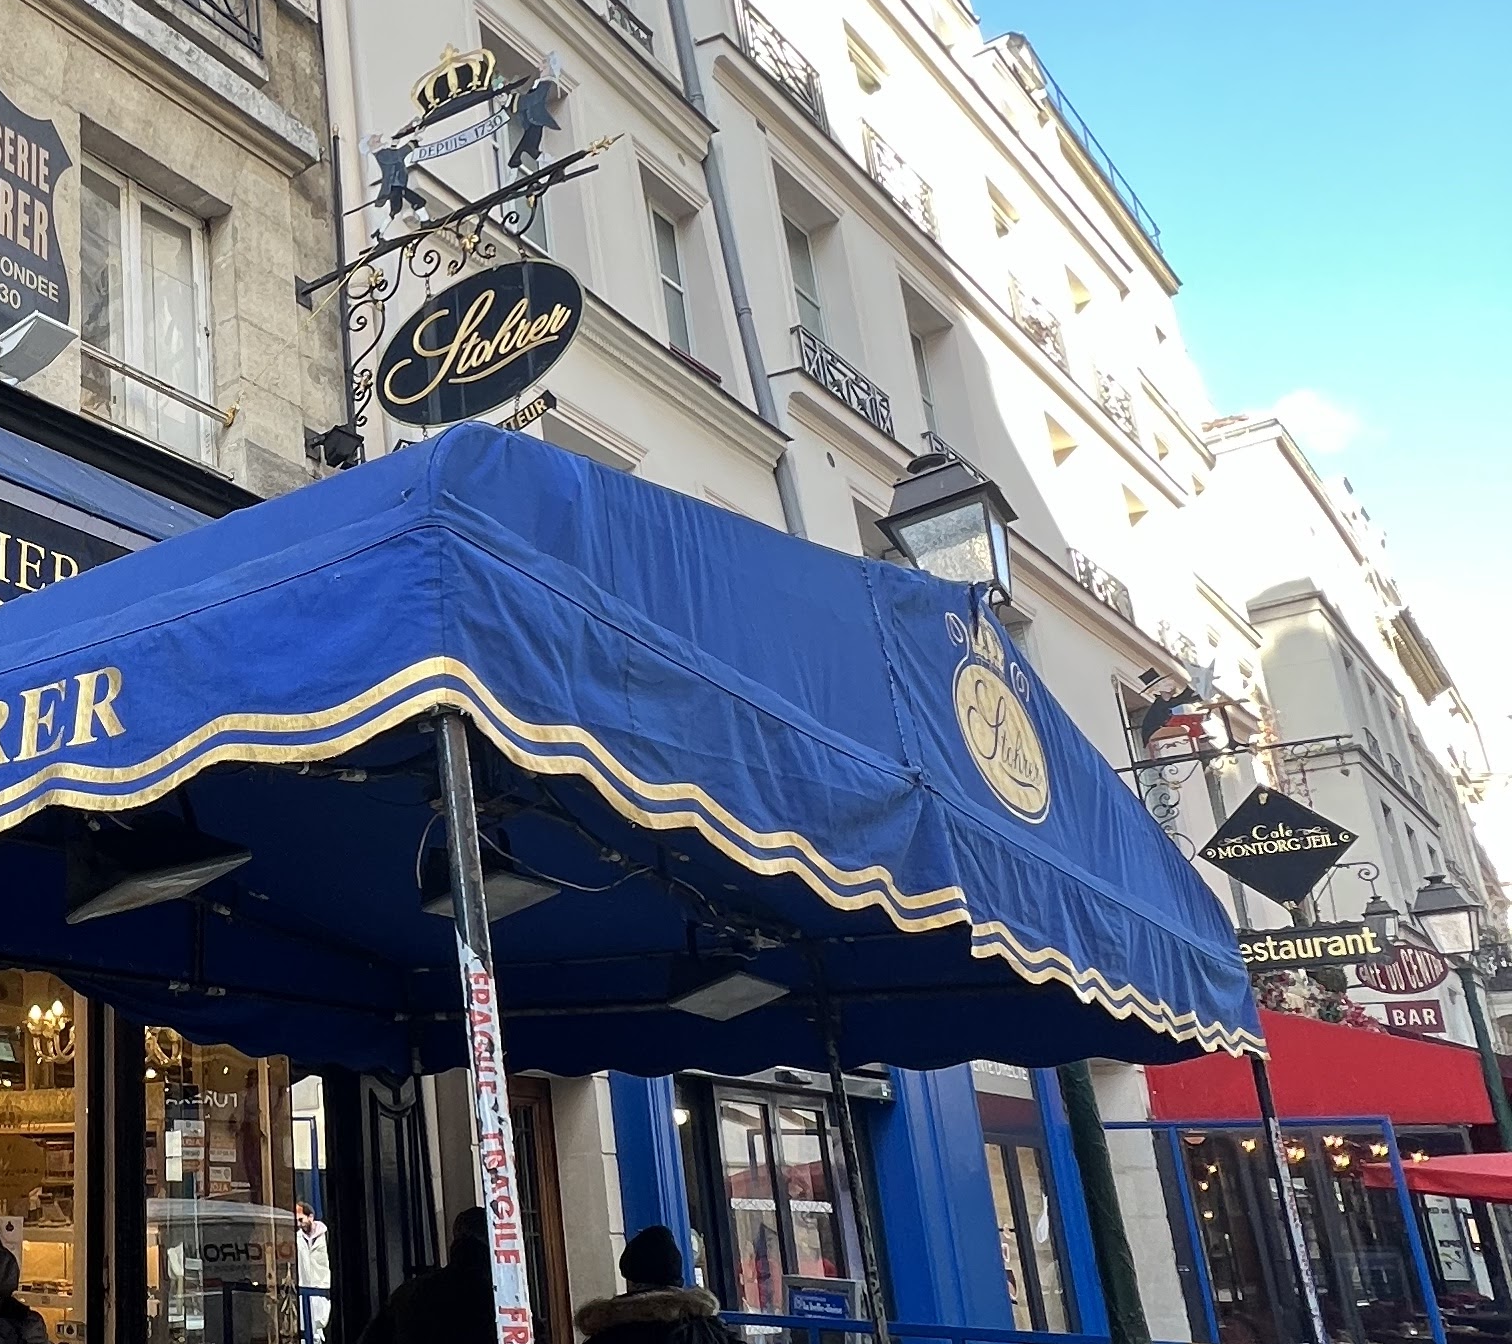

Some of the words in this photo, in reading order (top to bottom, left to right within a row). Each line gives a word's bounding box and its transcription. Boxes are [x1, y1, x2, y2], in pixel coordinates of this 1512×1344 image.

[418, 135, 468, 160] DEPUIS
[475, 115, 503, 141] 1730
[383, 289, 572, 405] Stohrer
[1238, 927, 1381, 965] estaurant
[1392, 1008, 1438, 1027] BAR
